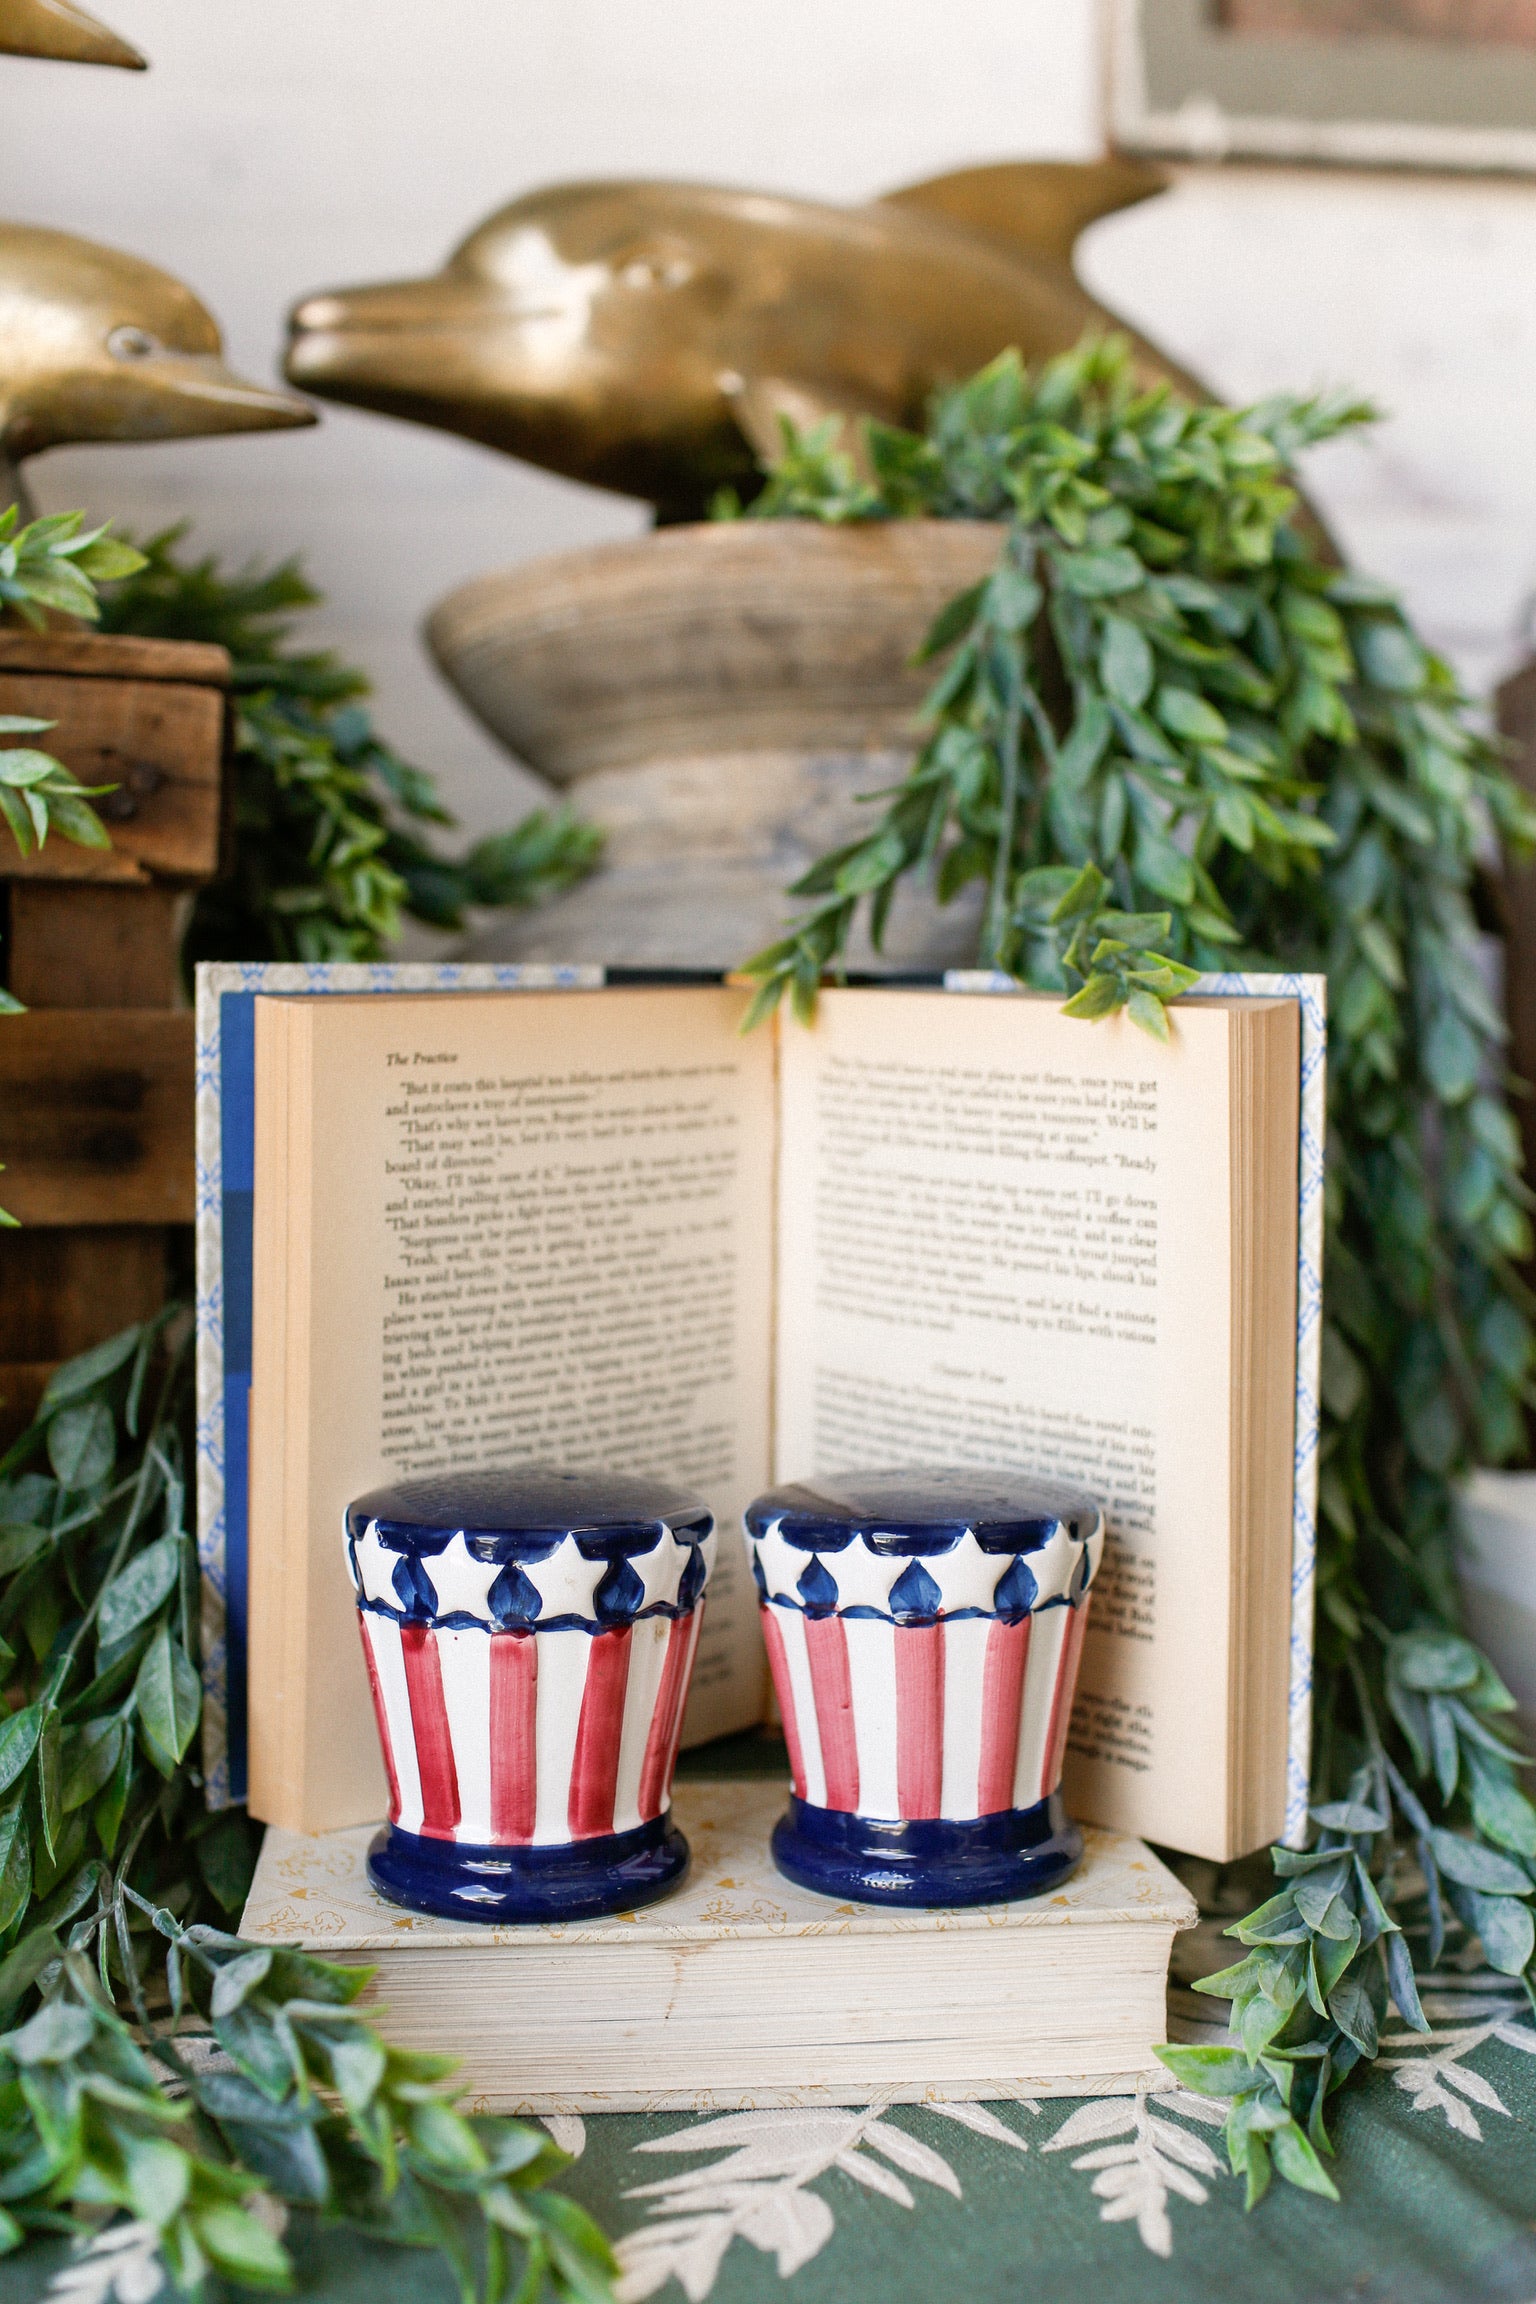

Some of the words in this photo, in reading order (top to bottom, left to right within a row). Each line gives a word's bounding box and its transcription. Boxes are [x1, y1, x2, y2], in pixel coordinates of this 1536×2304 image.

[386, 1053, 409, 1066] The
[413, 1051, 458, 1065] Practice
[431, 1081, 439, 1092] it
[1139, 1079, 1157, 1094] get
[385, 1100, 408, 1115] and
[1120, 1096, 1157, 1113] phone
[399, 1118, 441, 1133] "That's
[446, 1116, 469, 1133] why
[1142, 1116, 1157, 1130] be
[399, 1138, 434, 1152] "That
[438, 1139, 462, 1152] may
[470, 1133, 494, 1147] well
[385, 1157, 420, 1172] board
[424, 1156, 437, 1169] of
[385, 1196, 408, 1211] and
[412, 1193, 453, 1209] started
[458, 1190, 500, 1209] pulling
[1124, 1193, 1157, 1209] down
[385, 1215, 419, 1230] "That
[1136, 1218, 1157, 1229] can
[1084, 1228, 1106, 1242] and
[425, 1268, 448, 1283] said
[1139, 1272, 1157, 1287] his
[398, 1291, 416, 1304] He
[420, 1285, 462, 1302] started
[467, 1284, 497, 1297] down
[383, 1311, 415, 1330] place
[434, 1324, 452, 1338] the
[382, 1351, 401, 1365] ing
[382, 1370, 395, 1382] in
[399, 1365, 431, 1380] white
[383, 1385, 405, 1400] and
